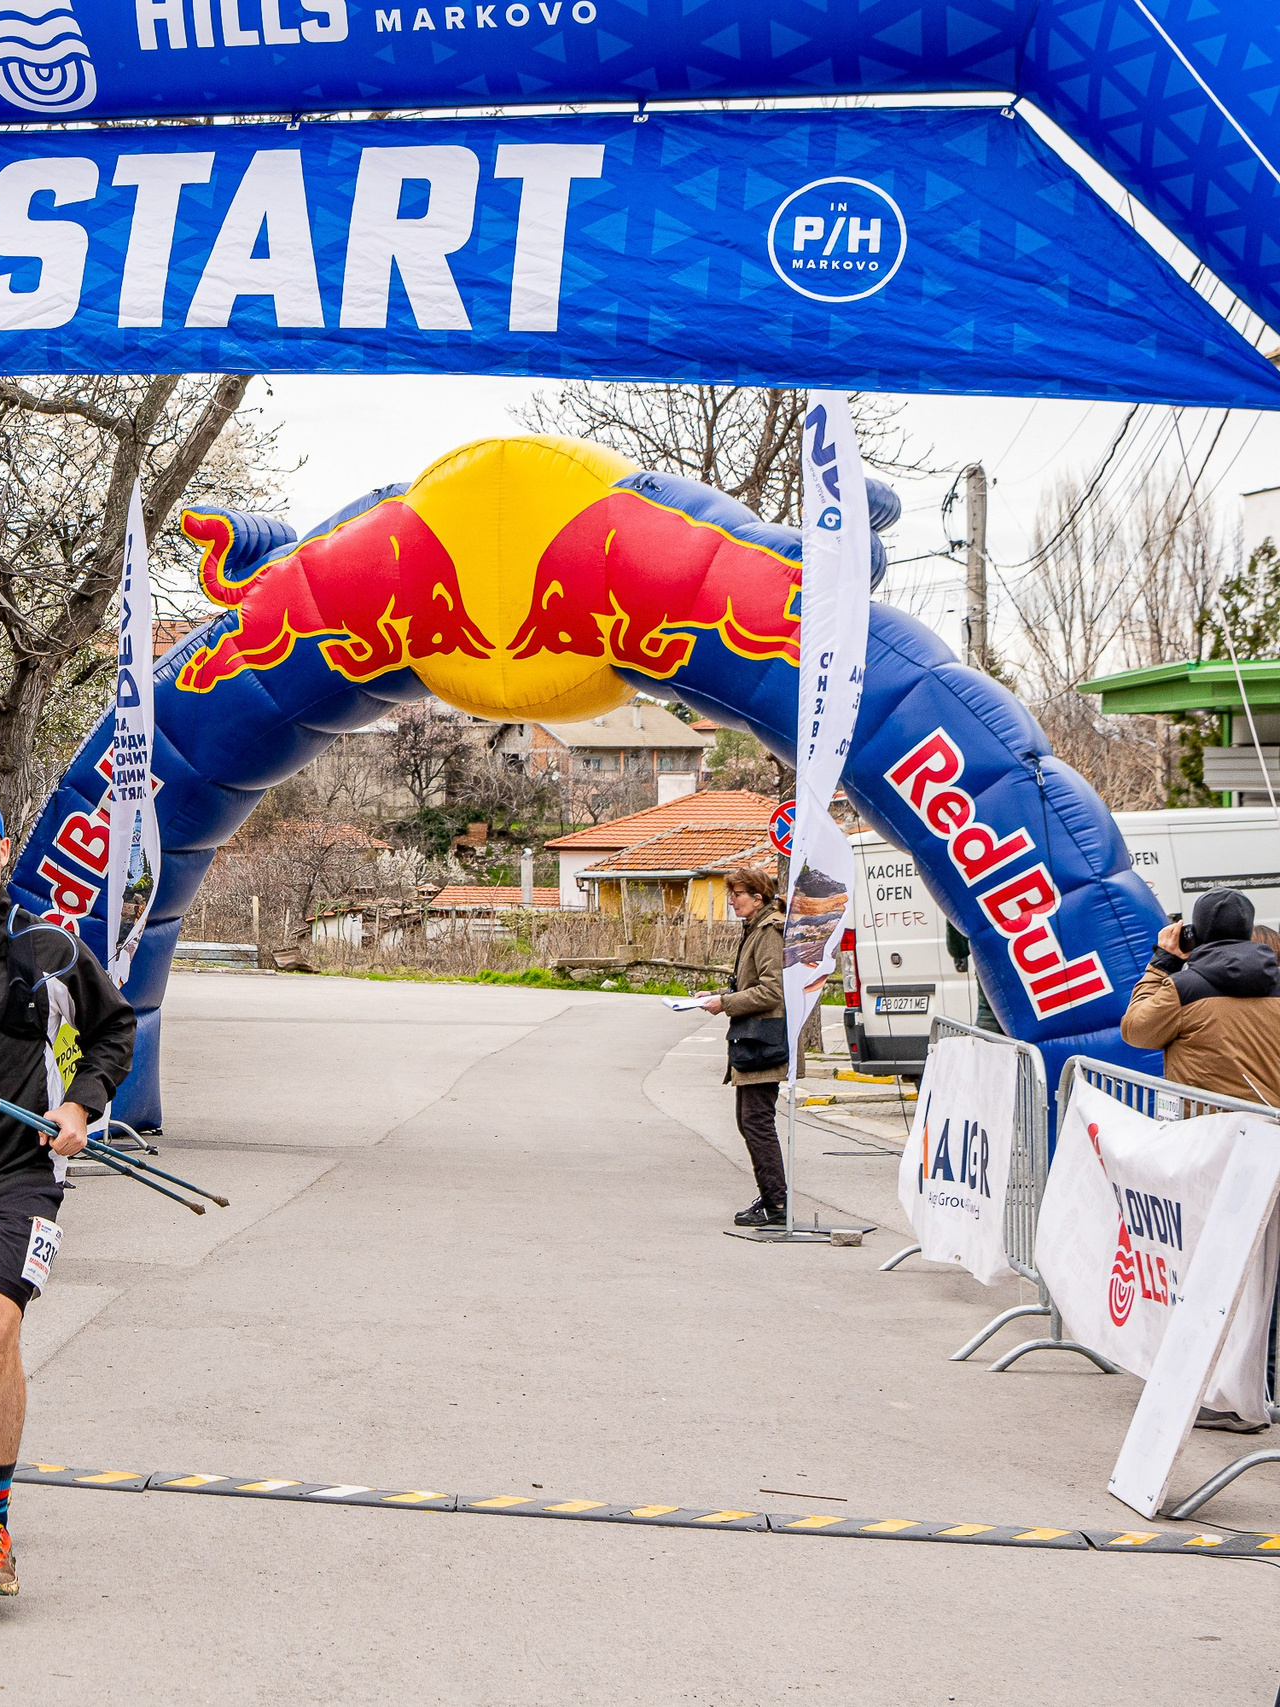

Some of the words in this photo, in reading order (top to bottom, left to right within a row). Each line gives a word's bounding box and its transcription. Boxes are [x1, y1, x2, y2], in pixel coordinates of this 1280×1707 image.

[136, 0, 349, 50] HILLS
[375, 0, 598, 33] MARKOVO
[830, 202, 847, 212] IN
[793, 216, 882, 256] P/H
[791, 259, 880, 271] MARKOVO
[888, 732, 1029, 882] Red
[982, 868, 1108, 1014] Bull
[876, 884, 913, 901] ÖFEN
[862, 910, 929, 929] LEITER
[893, 997, 914, 1010] 0271
